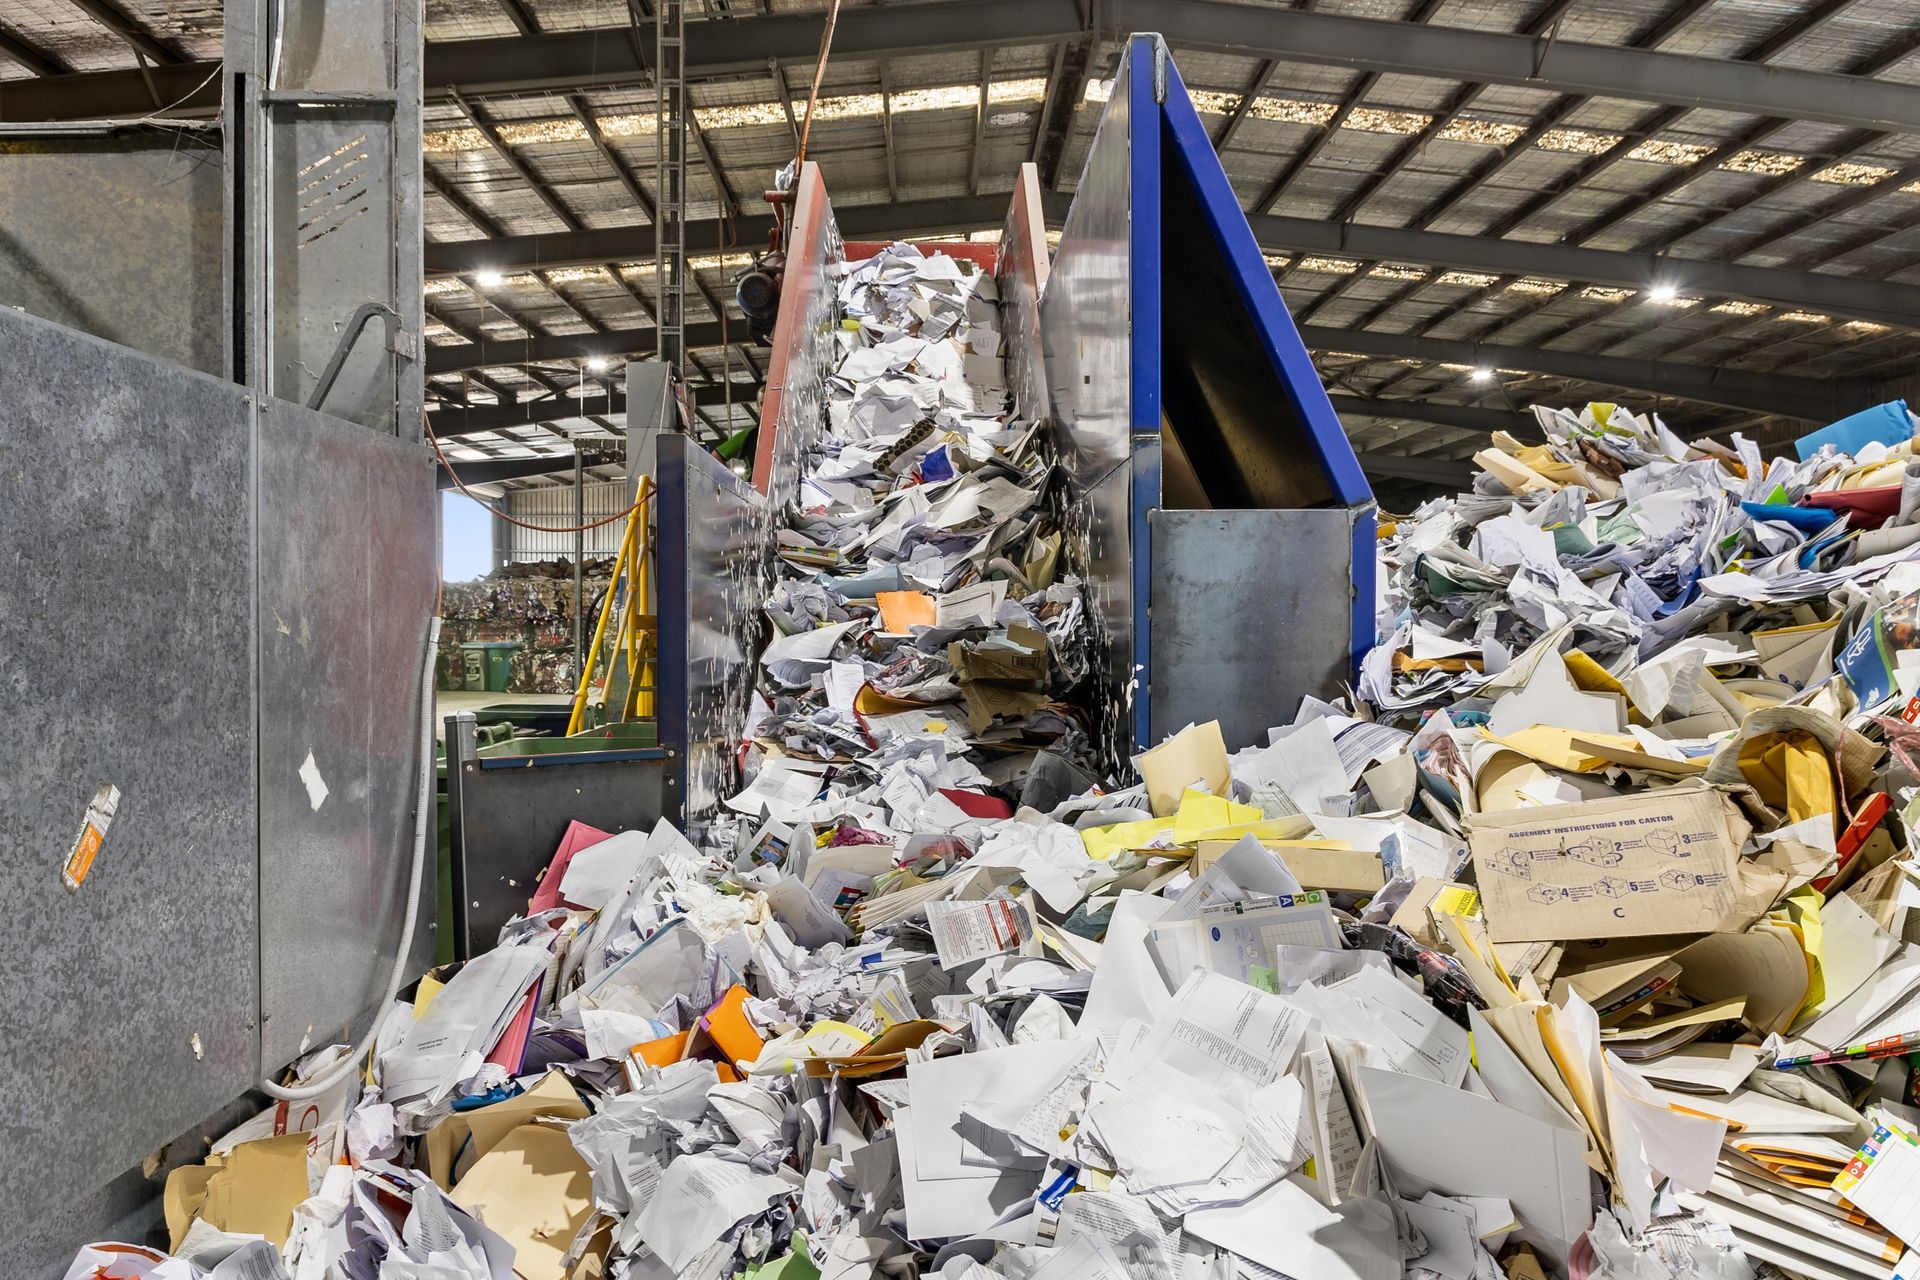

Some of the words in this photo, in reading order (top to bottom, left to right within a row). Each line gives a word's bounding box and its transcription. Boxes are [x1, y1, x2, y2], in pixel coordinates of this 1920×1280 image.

[1508, 828, 1551, 839] ASSEMBLY
[1554, 821, 1617, 834] INSTRUCTIONS
[1619, 819, 1637, 827] FOR
[1638, 814, 1674, 825] CARTON
[1682, 834, 1691, 844] 3
[1614, 842, 1623, 851] 2
[1528, 851, 1534, 860] 1
[1695, 875, 1705, 885] 6
[1630, 881, 1639, 892] 5
[1561, 888, 1570, 898] 4
[1613, 907, 1625, 918] C
